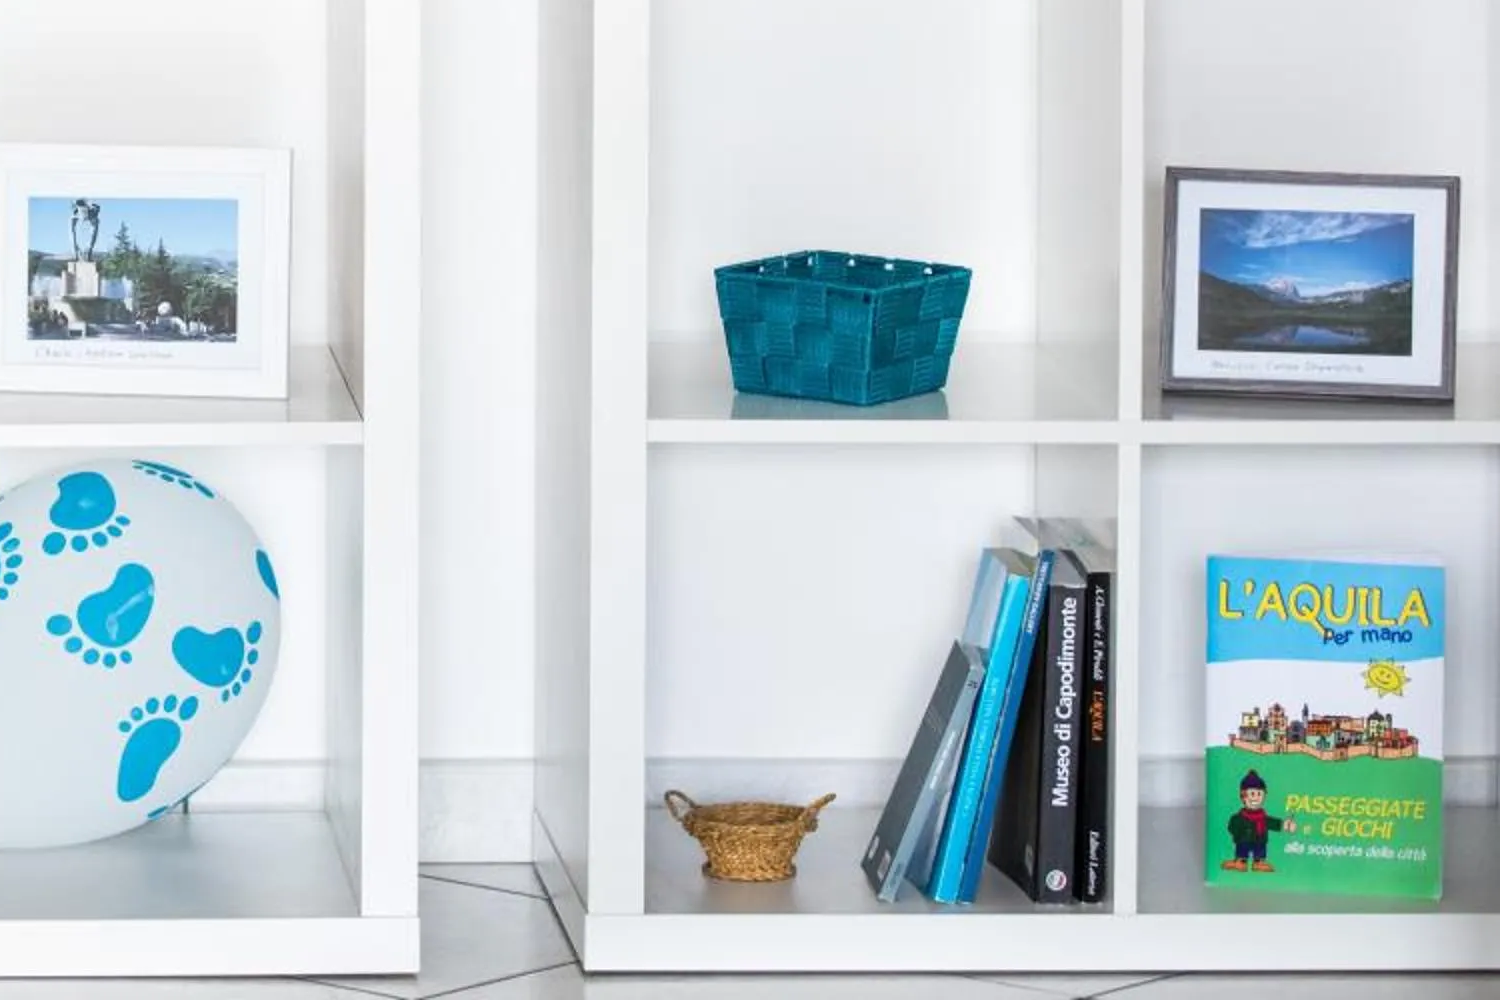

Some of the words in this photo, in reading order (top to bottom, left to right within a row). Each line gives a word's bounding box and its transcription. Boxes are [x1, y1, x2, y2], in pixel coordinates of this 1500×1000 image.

[1218, 578, 1432, 638] L'AQUILA
[1322, 626, 1354, 645] Per
[1361, 627, 1414, 645] mano
[1056, 597, 1078, 720] Capodimonte
[1054, 722, 1072, 737] di
[1051, 740, 1072, 808] Museo
[1284, 795, 1427, 820] PASSEGGIATE
[1321, 817, 1395, 840] GIOCHI
[1307, 842, 1364, 859] scoperta
